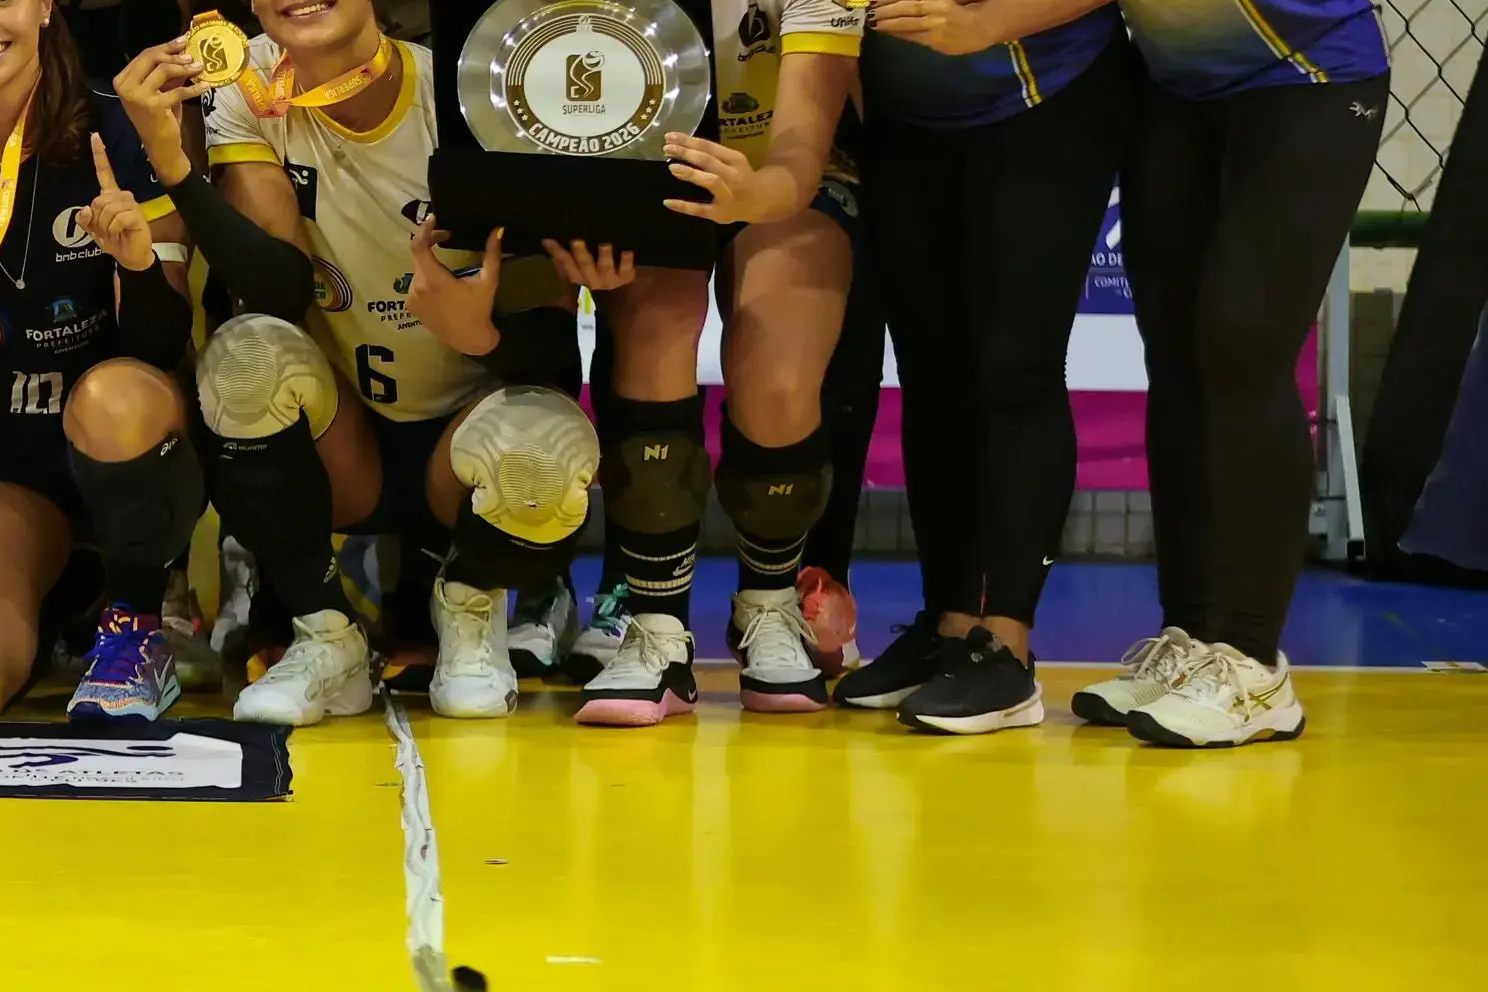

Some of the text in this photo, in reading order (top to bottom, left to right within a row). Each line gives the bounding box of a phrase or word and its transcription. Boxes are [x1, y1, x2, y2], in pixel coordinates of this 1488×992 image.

[562, 104, 606, 115] SUPERLIGA
[529, 122, 641, 152] CAMPEÃO 2026
[77, 247, 103, 260] club
[26, 309, 108, 341] FORTALEZA
[355, 344, 398, 404] 6
